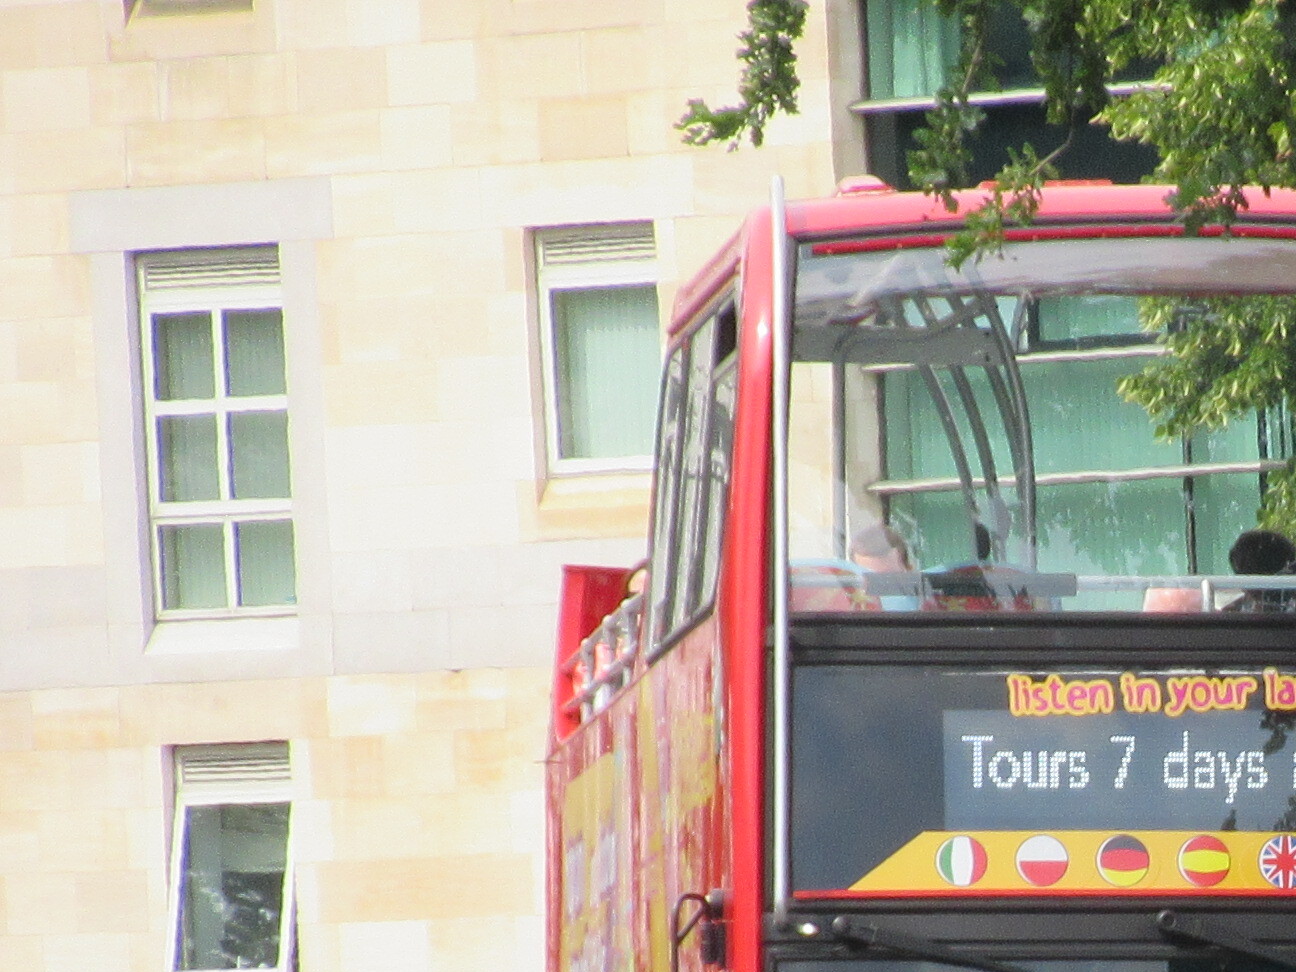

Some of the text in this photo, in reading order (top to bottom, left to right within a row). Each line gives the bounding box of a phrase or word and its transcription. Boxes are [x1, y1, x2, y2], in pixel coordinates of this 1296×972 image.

[1007, 673, 1114, 716] listen
[1119, 672, 1161, 714] in
[1164, 676, 1258, 717] your
[961, 735, 1090, 790] Tours
[1110, 735, 1136, 789] 7
[1163, 730, 1269, 804] days
